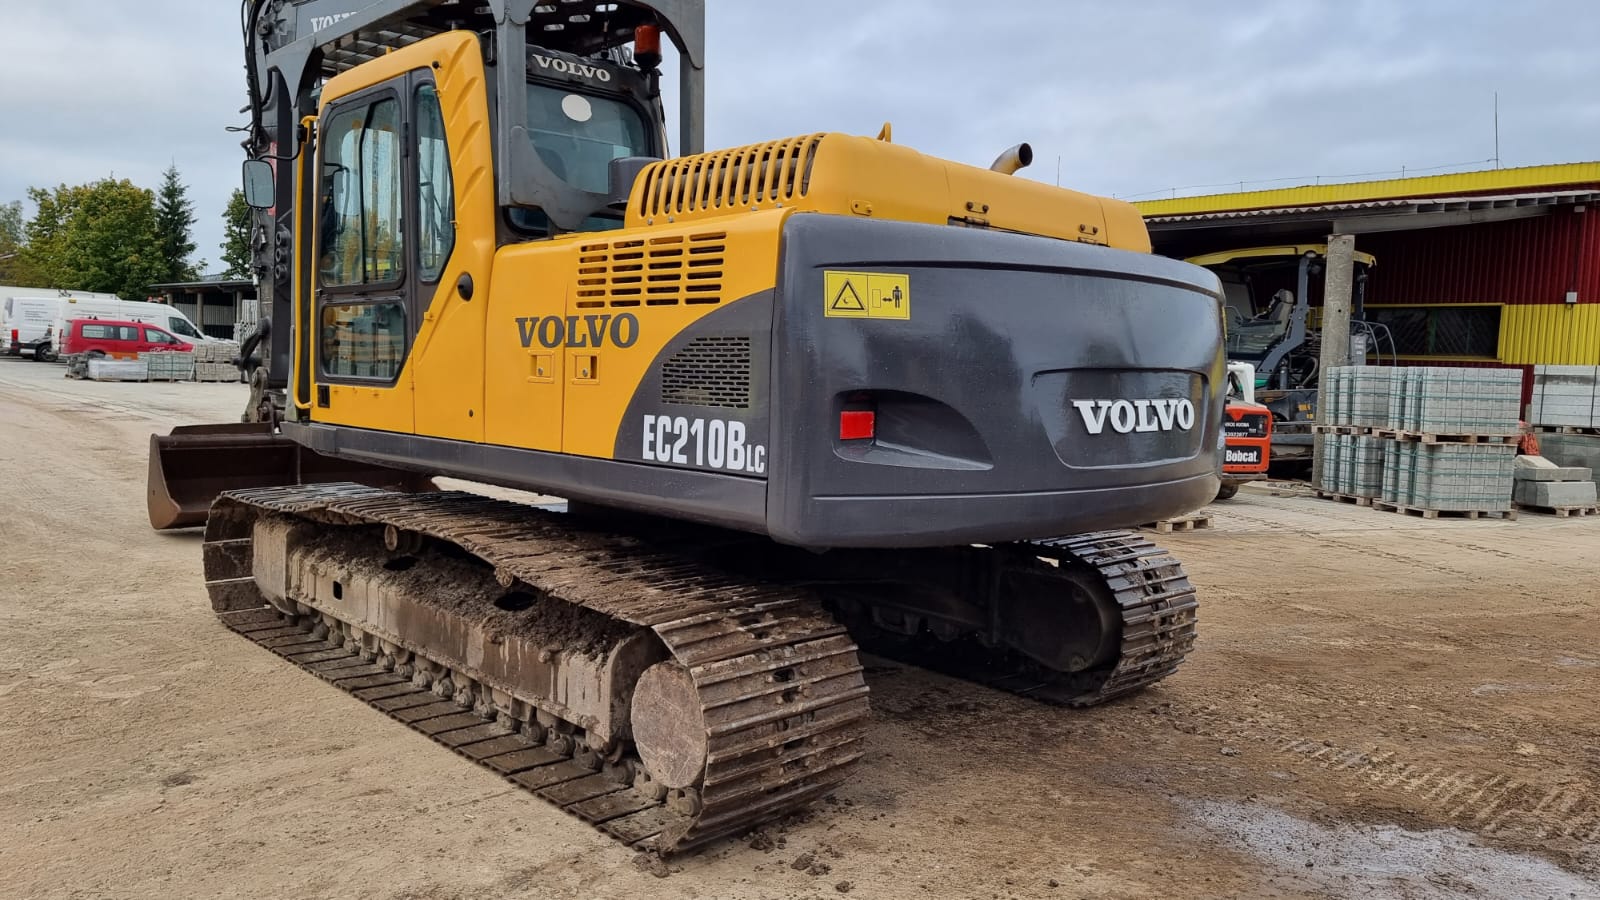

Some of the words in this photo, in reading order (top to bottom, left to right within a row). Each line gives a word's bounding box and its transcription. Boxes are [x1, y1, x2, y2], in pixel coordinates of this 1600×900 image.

[532, 54, 611, 82] VOLVO
[515, 312, 640, 349] VOLVO
[1072, 398, 1195, 435] VOLVO
[1225, 449, 1257, 462] Bobcat
